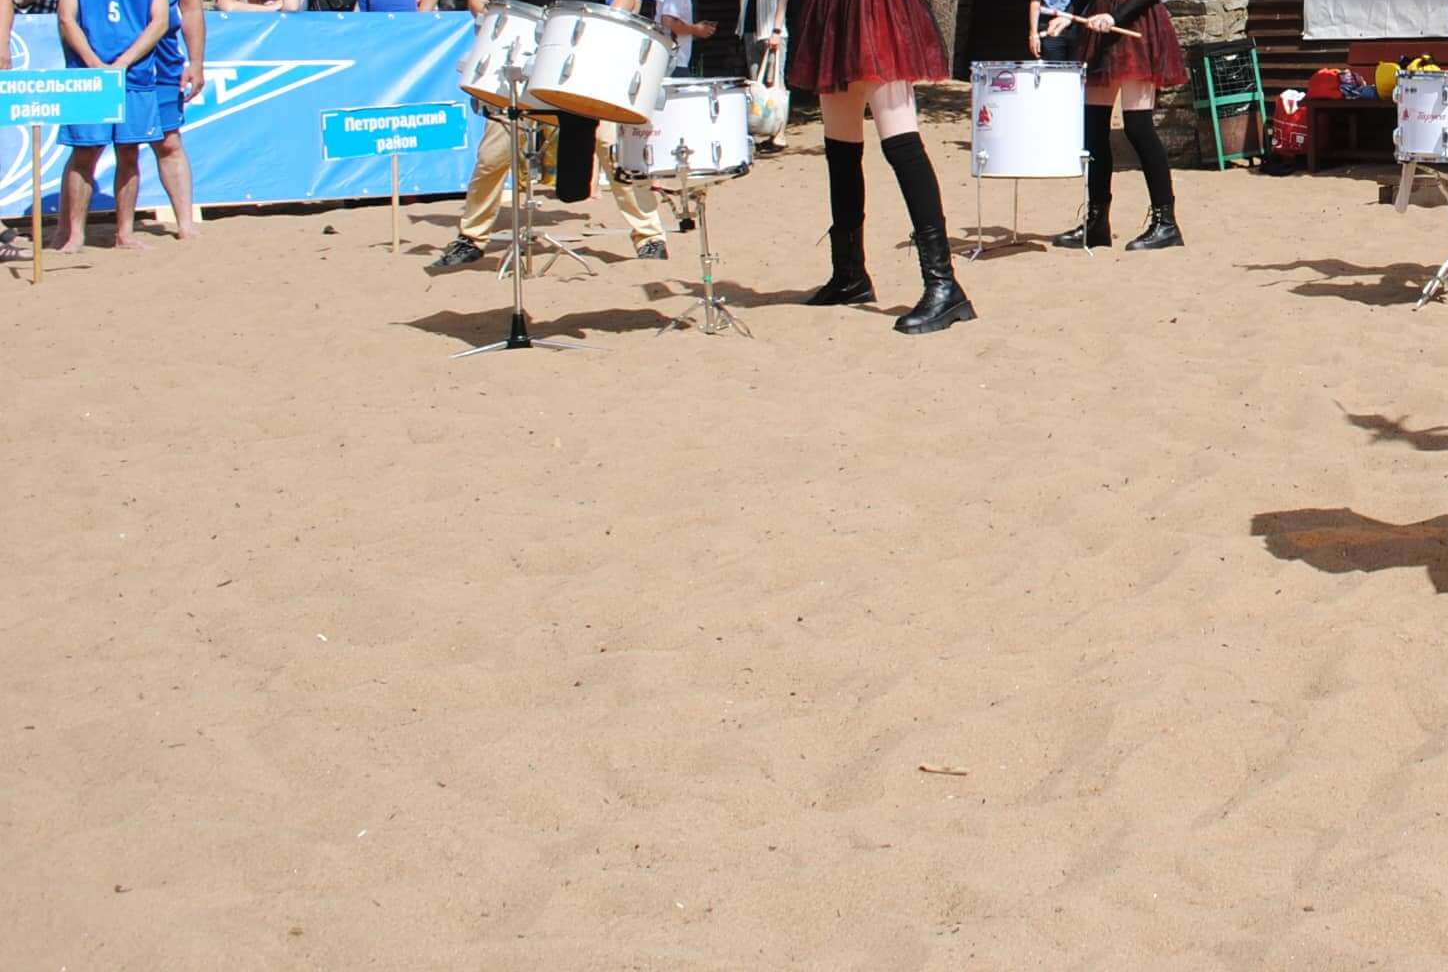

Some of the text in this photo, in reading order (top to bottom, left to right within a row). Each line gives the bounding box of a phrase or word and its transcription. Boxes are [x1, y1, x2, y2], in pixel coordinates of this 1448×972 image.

[108, 1, 121, 23] 5
[0, 76, 103, 93] сносельский
[10, 102, 61, 120] район
[344, 110, 447, 132] Петроградский
[376, 135, 417, 152] район
